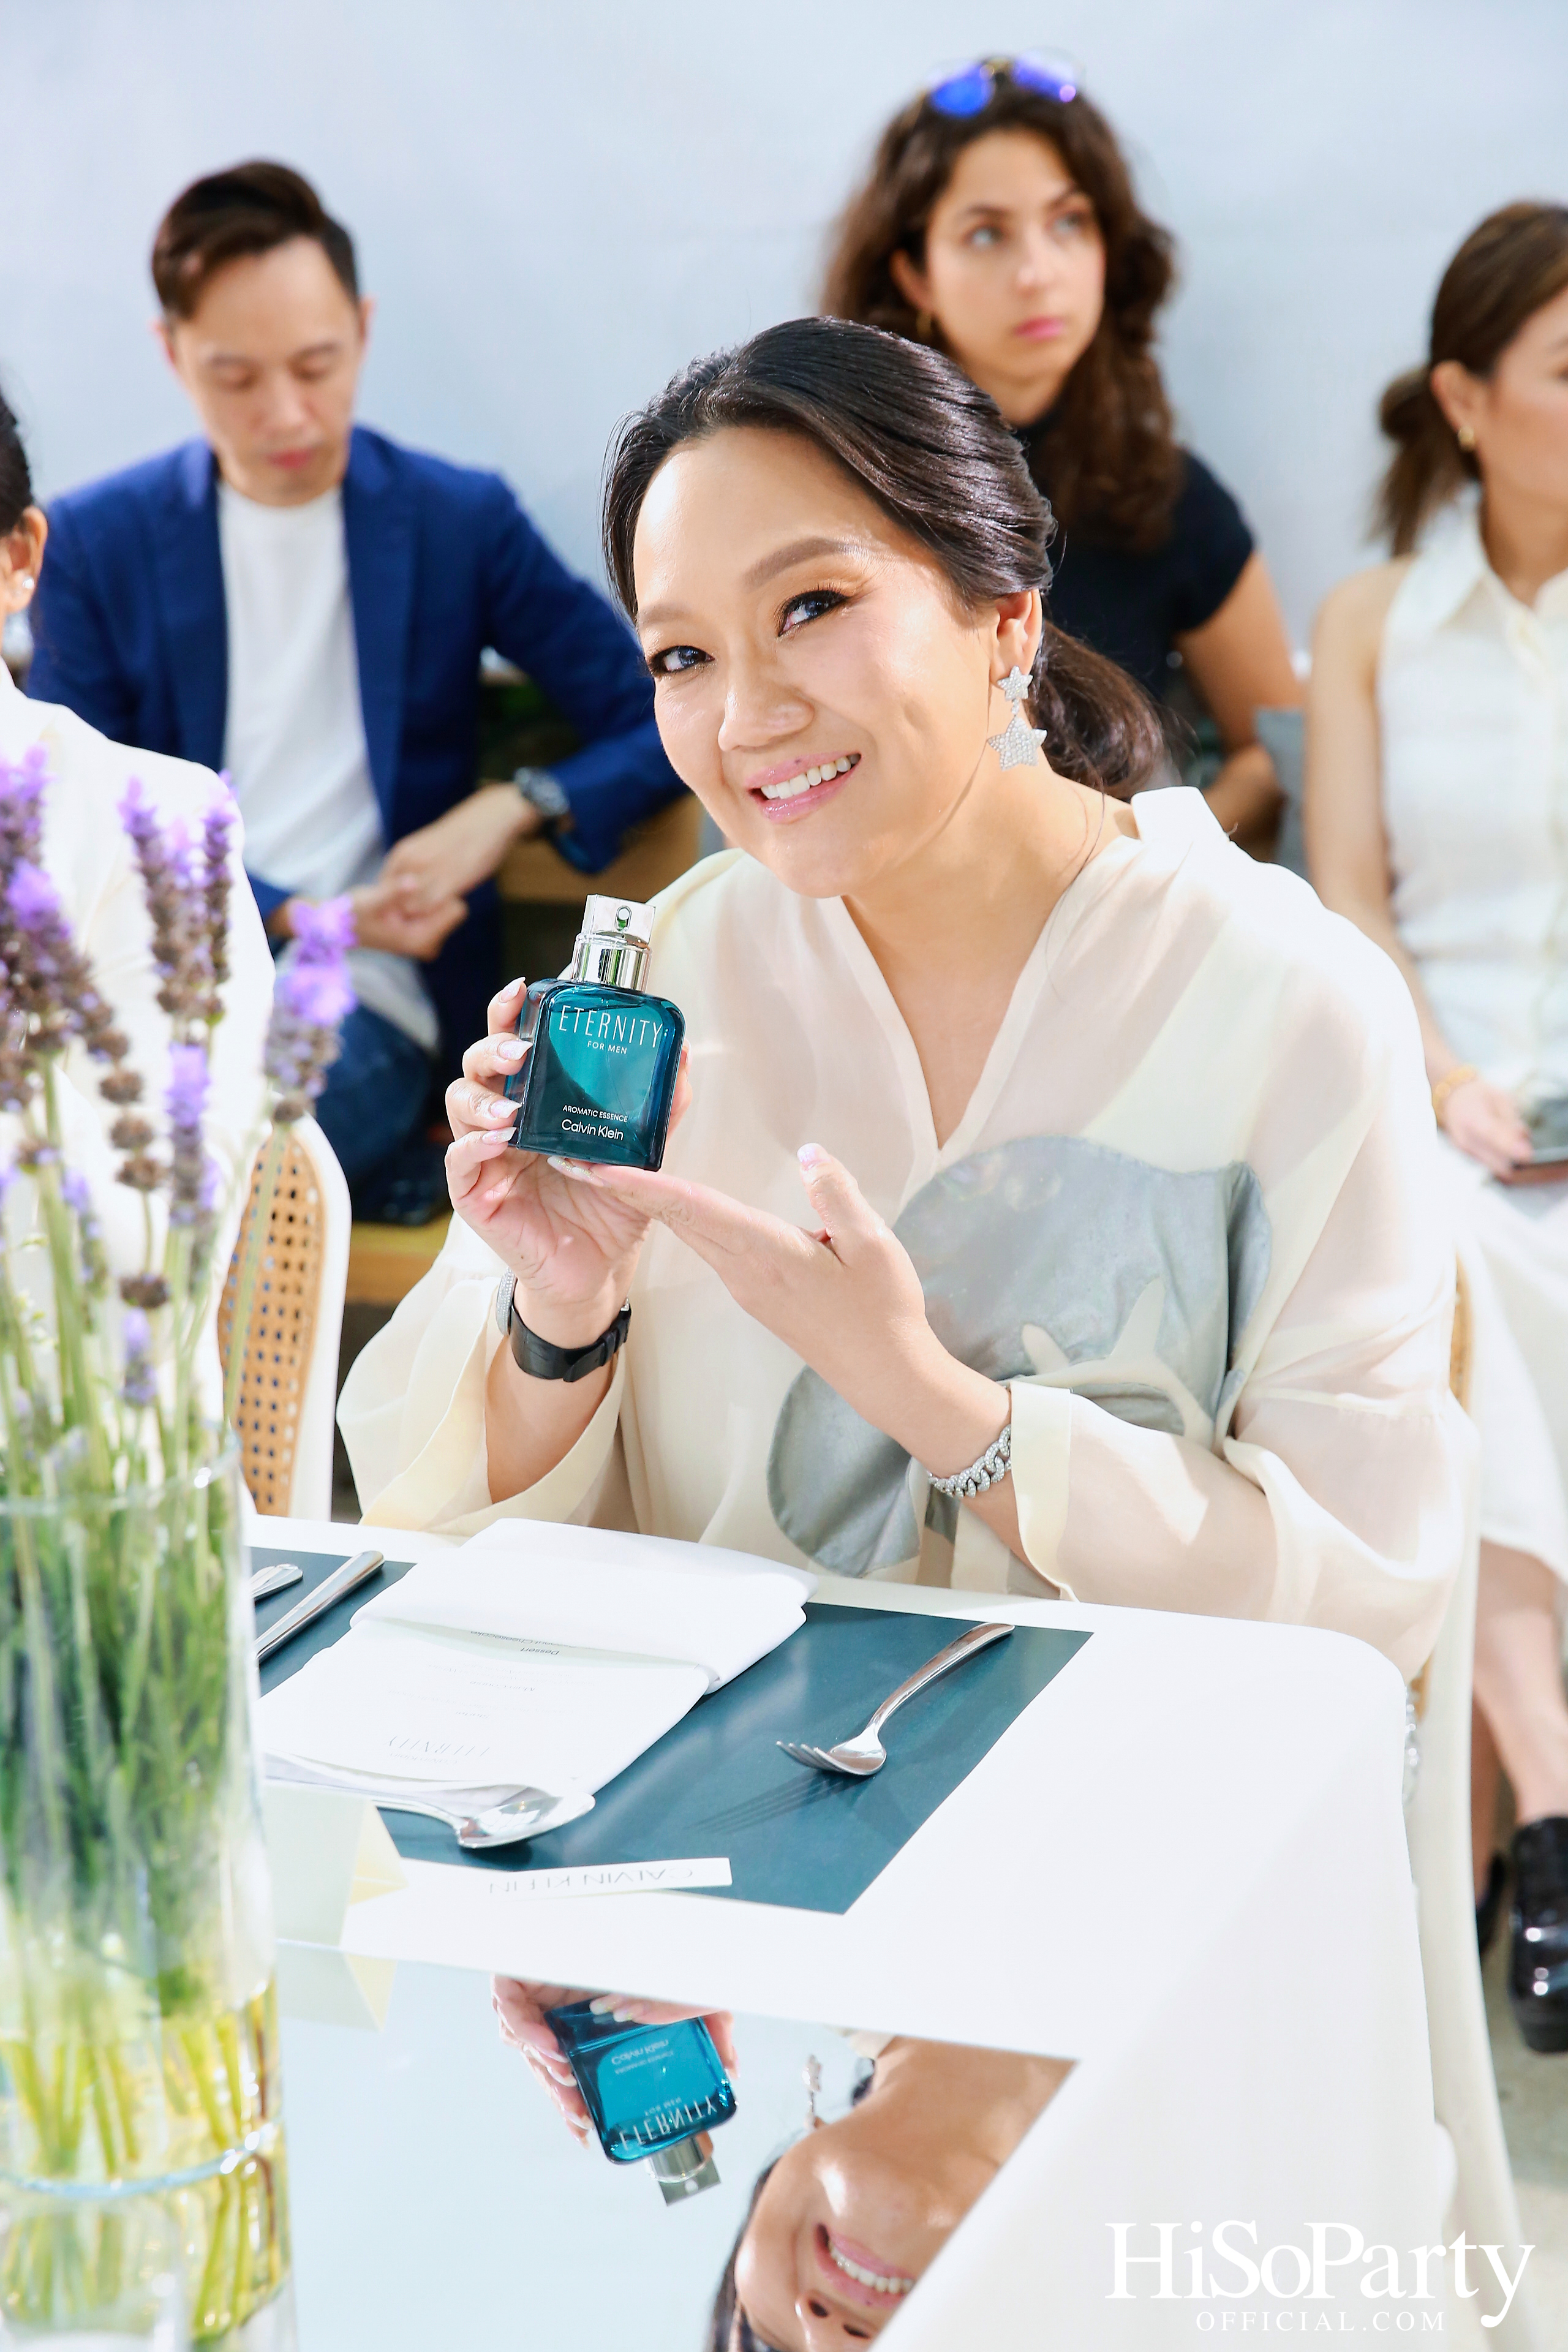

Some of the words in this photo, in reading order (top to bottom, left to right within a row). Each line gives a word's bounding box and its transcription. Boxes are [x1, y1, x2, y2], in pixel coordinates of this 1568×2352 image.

[559, 1005, 663, 1048] ETERNITY
[587, 1041, 605, 1052] FOR
[608, 1044, 627, 1054] MEN
[562, 1104, 598, 1117] AROMATIC
[599, 1111, 628, 1123] ESSENCE
[562, 1119, 596, 1136] Calvin
[598, 1125, 624, 1140] Klein
[519, 1647, 560, 1656] Dessert
[584, 1868, 693, 1885] CALVIN
